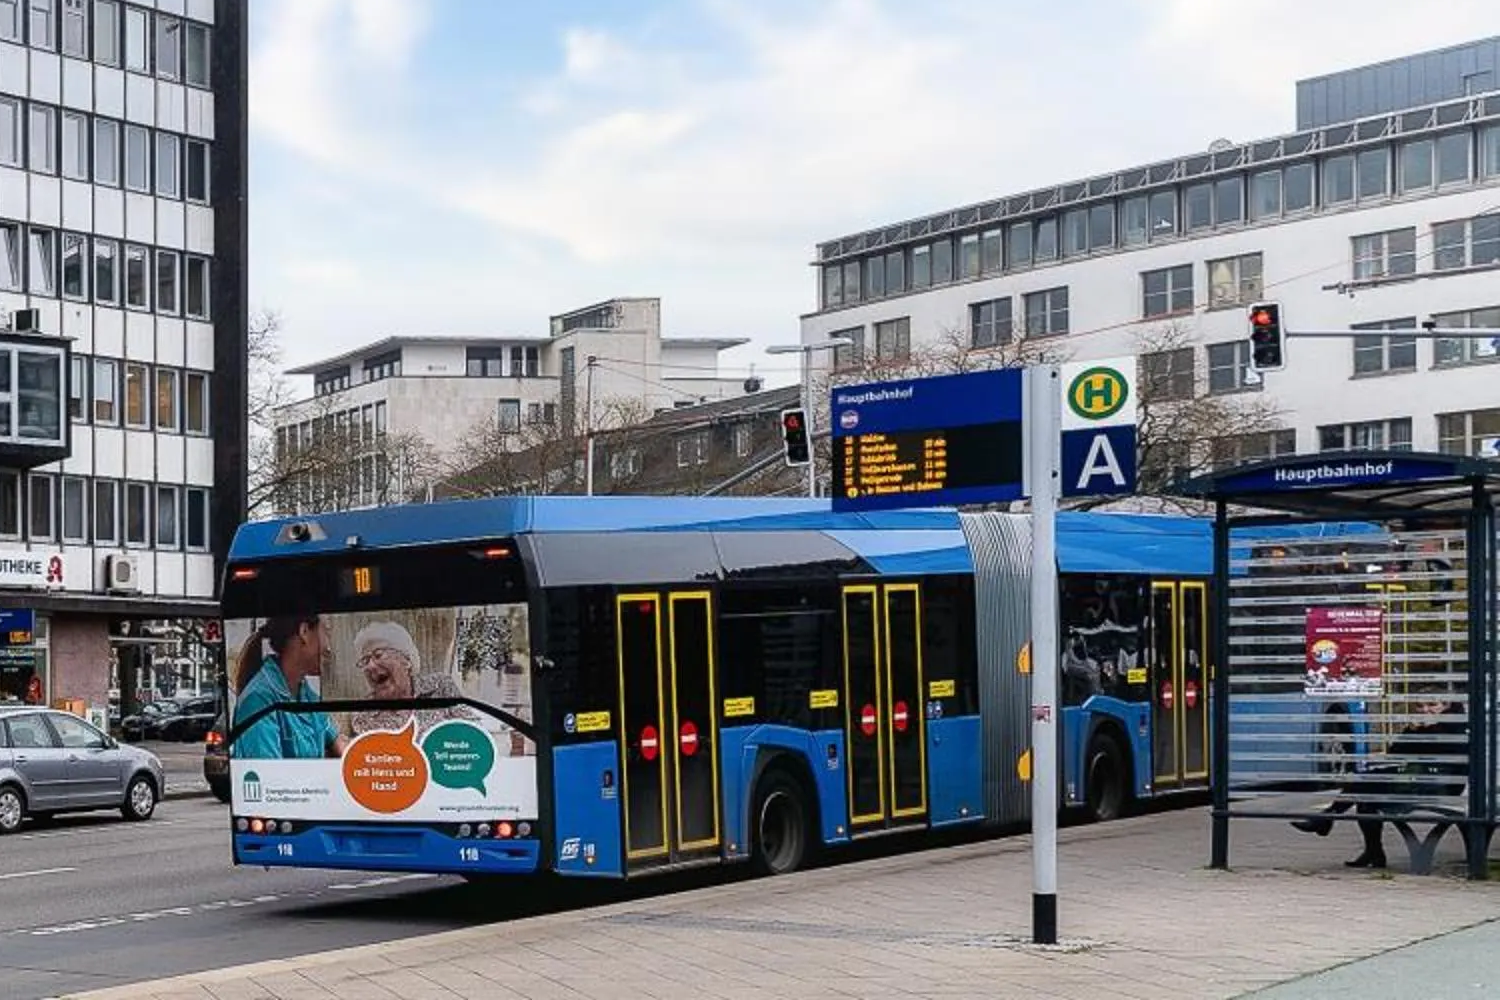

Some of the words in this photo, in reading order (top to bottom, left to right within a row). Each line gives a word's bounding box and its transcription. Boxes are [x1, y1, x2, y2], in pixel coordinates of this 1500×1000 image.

[837, 385, 913, 405] Hauptbahnhof
[1076, 433, 1127, 489] A
[1275, 460, 1394, 482] Hauptbahnhof
[354, 567, 370, 593] 10
[396, 766, 416, 777] und
